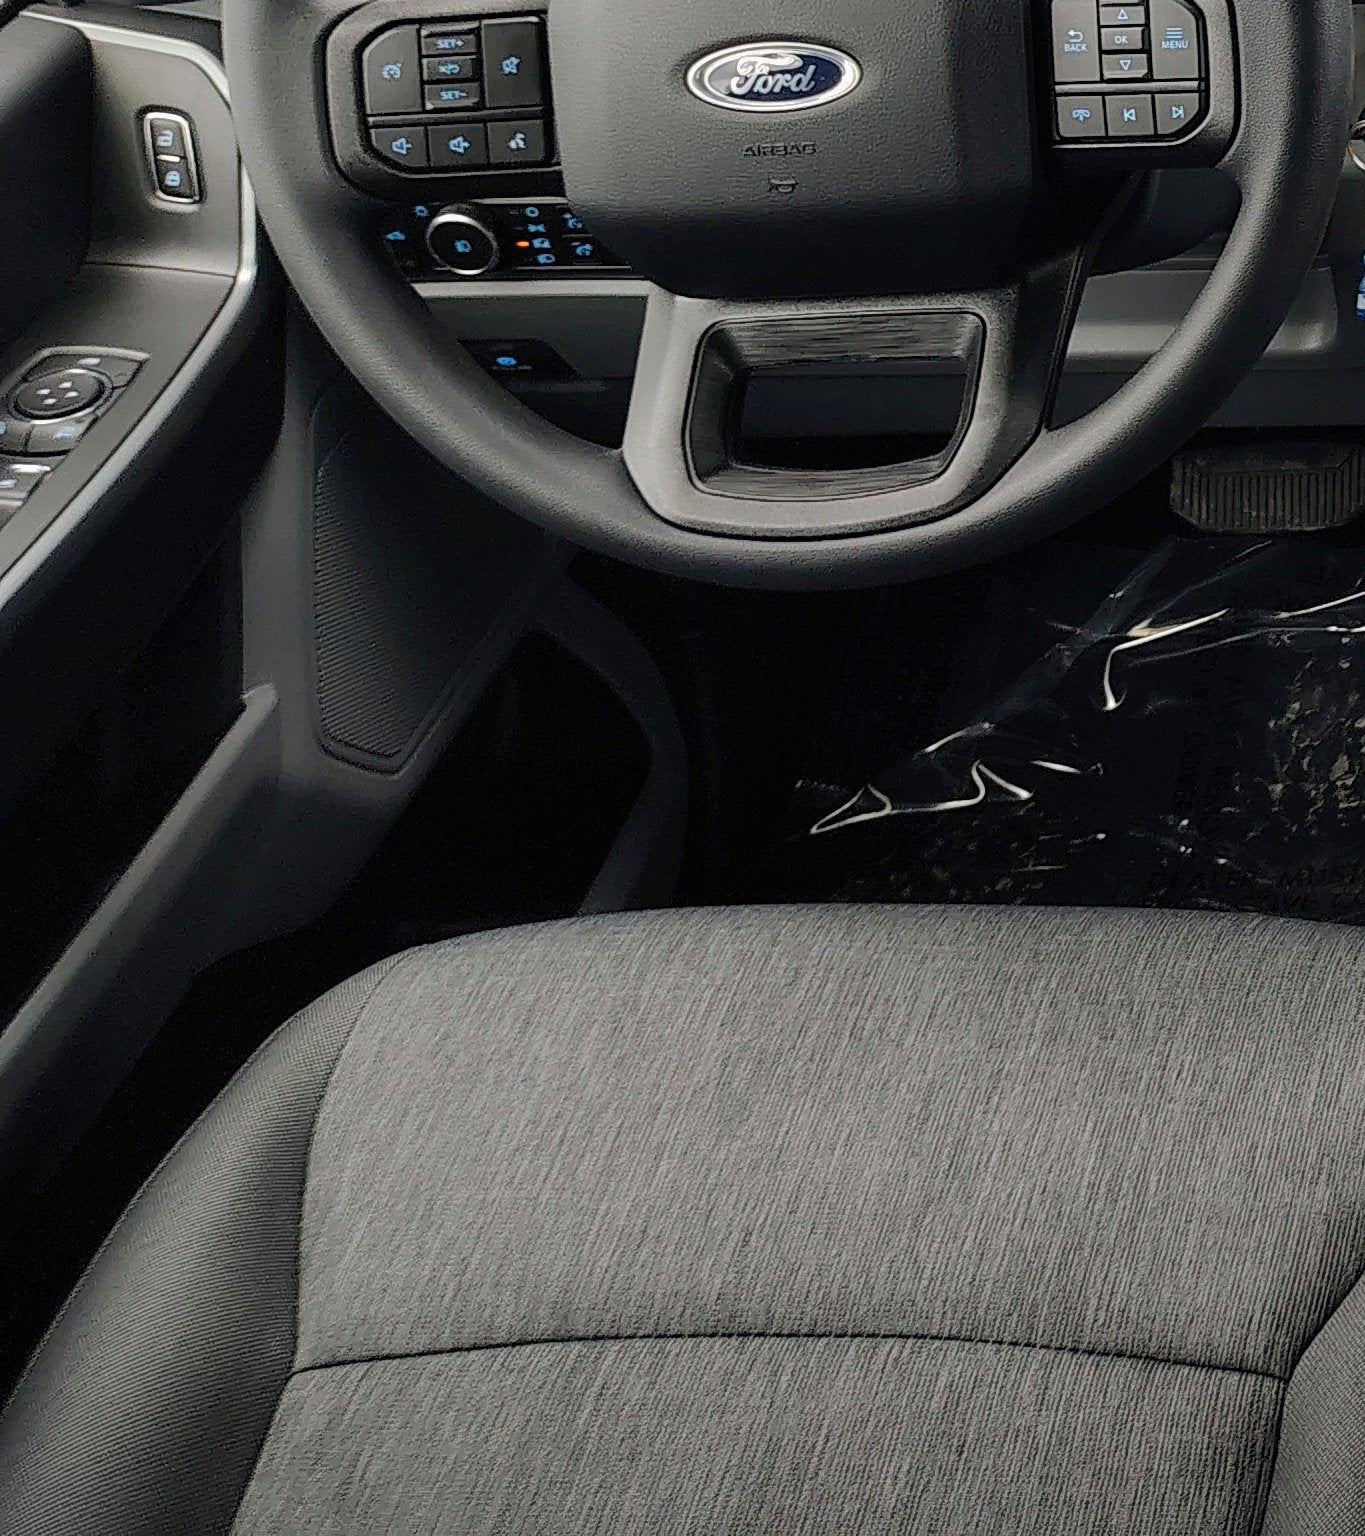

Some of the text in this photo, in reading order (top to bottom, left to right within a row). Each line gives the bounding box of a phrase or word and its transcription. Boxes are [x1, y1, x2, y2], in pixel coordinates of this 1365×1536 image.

[1113, 35, 1129, 45] OK
[1161, 40, 1189, 50] MENU
[1063, 43, 1088, 53] BACK
[729, 52, 816, 95] Ford
[741, 141, 818, 158] AIRBAG
